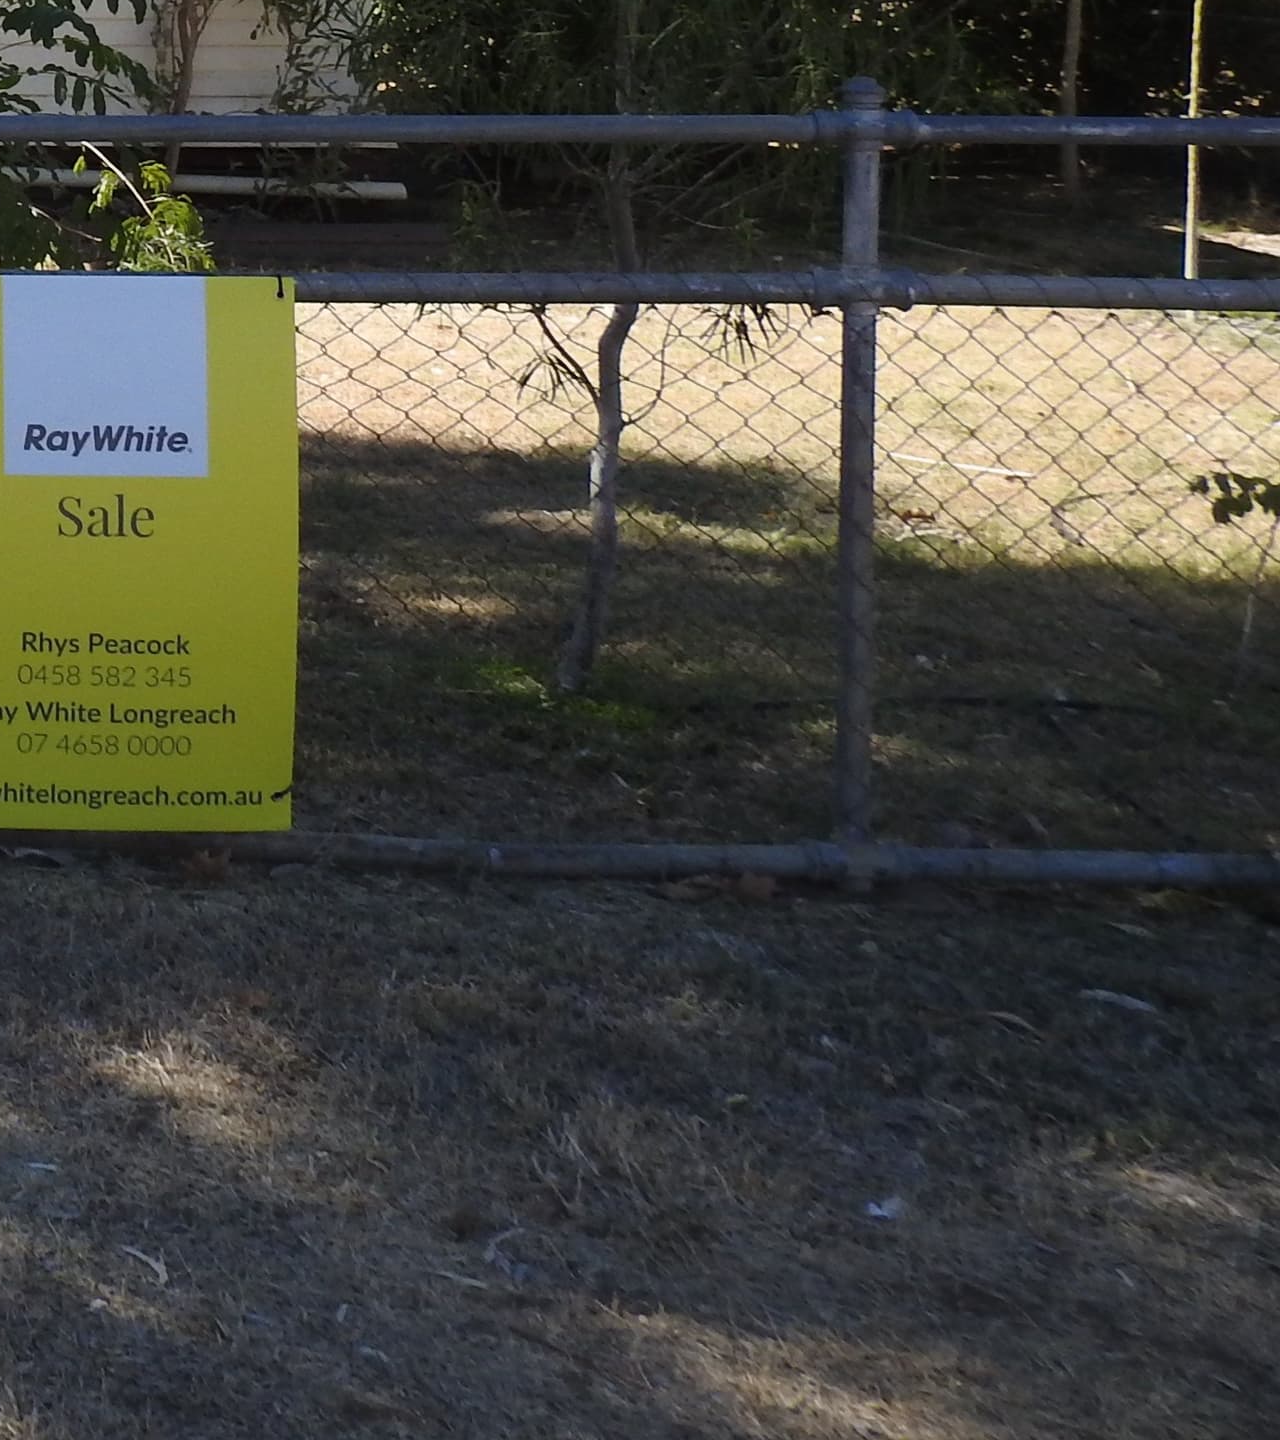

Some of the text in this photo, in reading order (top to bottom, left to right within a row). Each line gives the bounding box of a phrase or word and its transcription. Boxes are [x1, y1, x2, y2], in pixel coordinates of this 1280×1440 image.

[57, 493, 155, 538] Sale
[21, 631, 190, 657] Rhys Peacock
[17, 664, 192, 688] 0458 582 345
[25, 701, 101, 723] White
[109, 703, 236, 729] Longreach
[16, 732, 192, 757] 07 4658 0000
